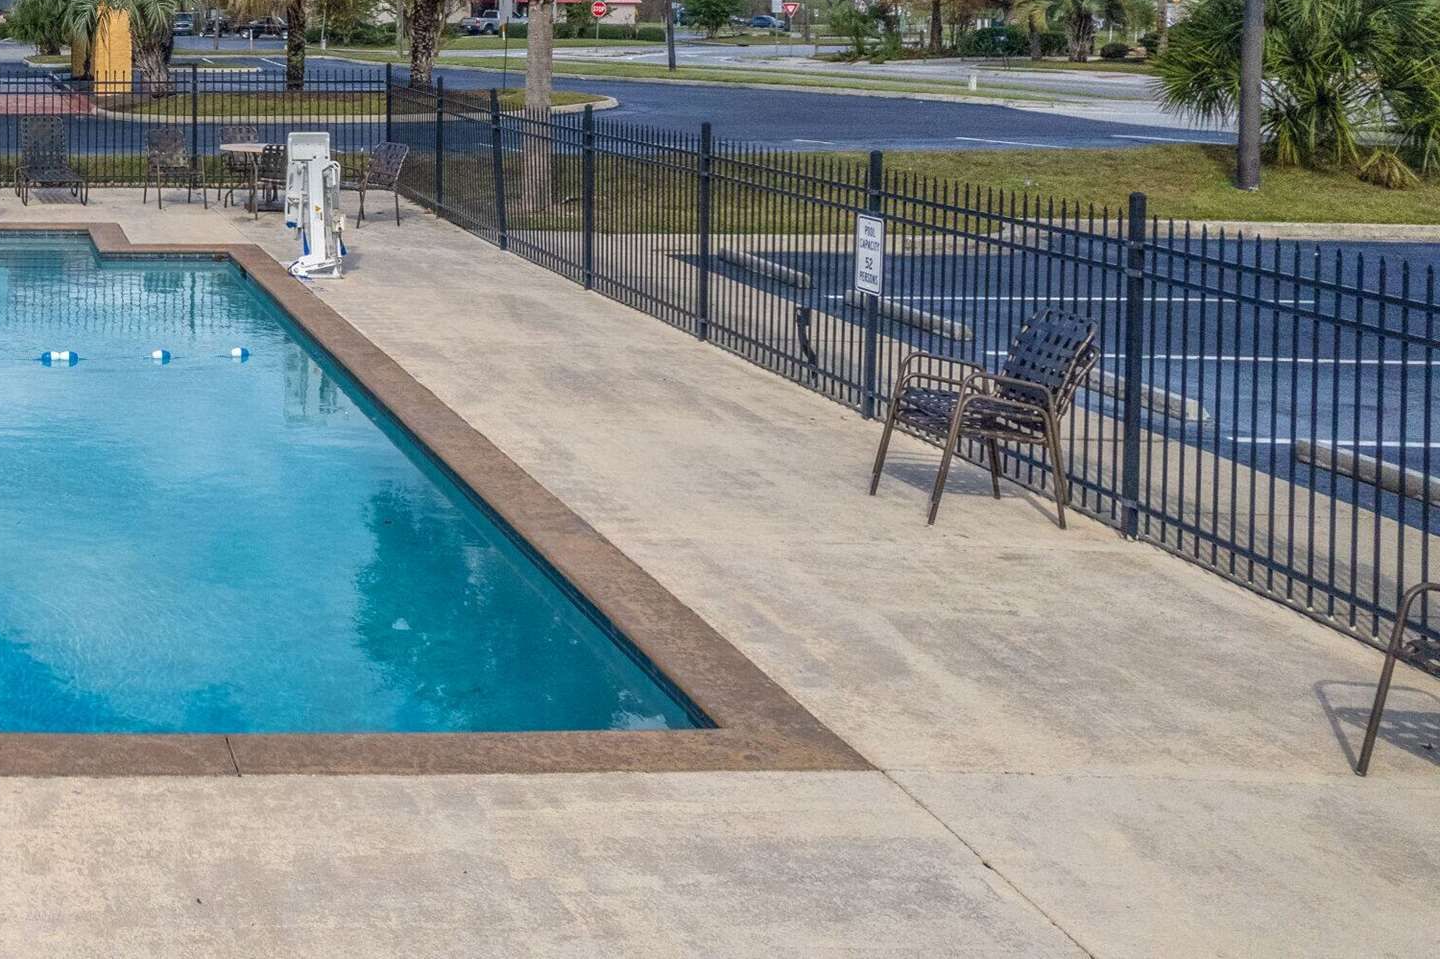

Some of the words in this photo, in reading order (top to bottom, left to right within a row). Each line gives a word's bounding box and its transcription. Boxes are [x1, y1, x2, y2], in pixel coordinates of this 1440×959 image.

[864, 225, 876, 238] POOL
[859, 238, 880, 252] CAPACITY
[865, 256, 874, 271] 52
[859, 270, 878, 286] PERSONS
